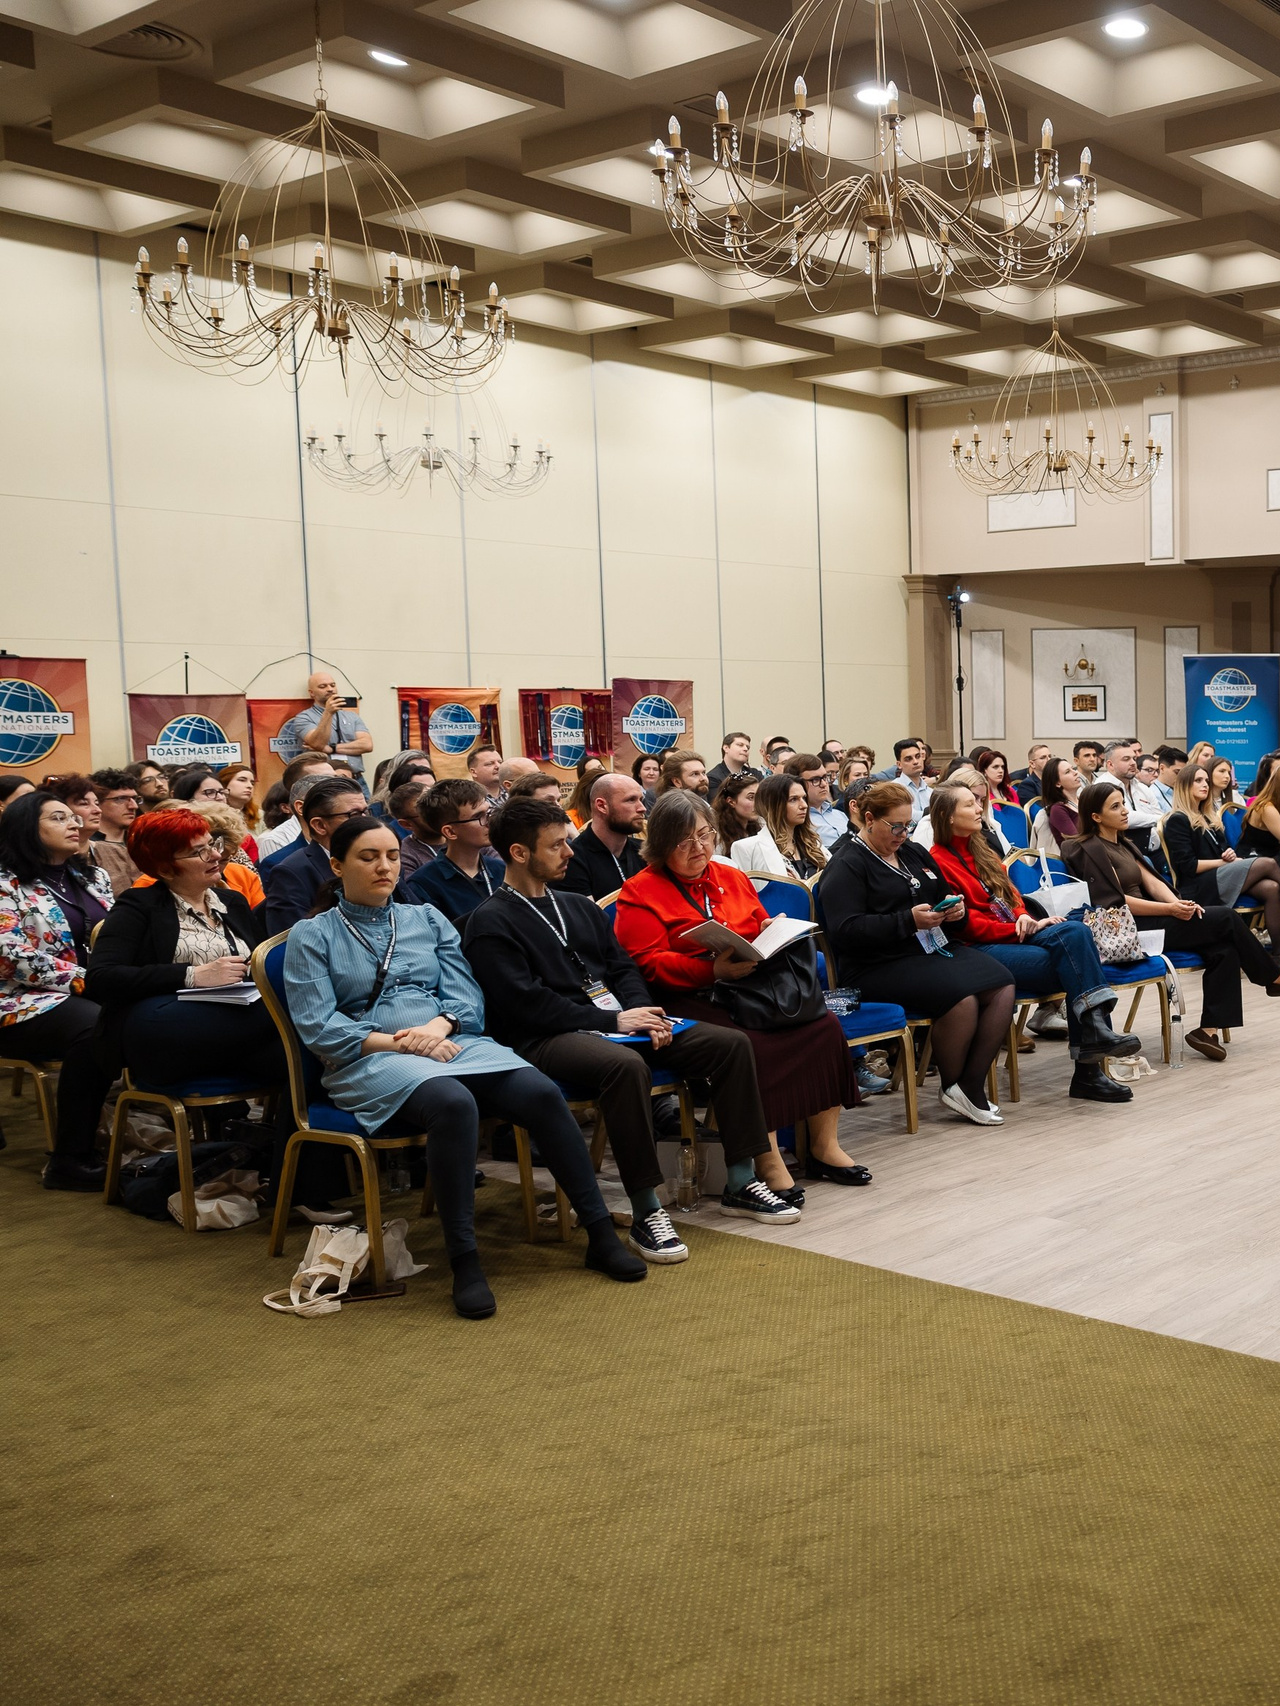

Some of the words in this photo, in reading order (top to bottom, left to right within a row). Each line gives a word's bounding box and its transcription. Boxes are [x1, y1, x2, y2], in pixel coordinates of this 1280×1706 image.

[625, 719, 684, 727] TOASTMASTERS
[150, 745, 238, 756] TOASTMASTERS
[160, 754, 228, 763] INTERNATIONAL
